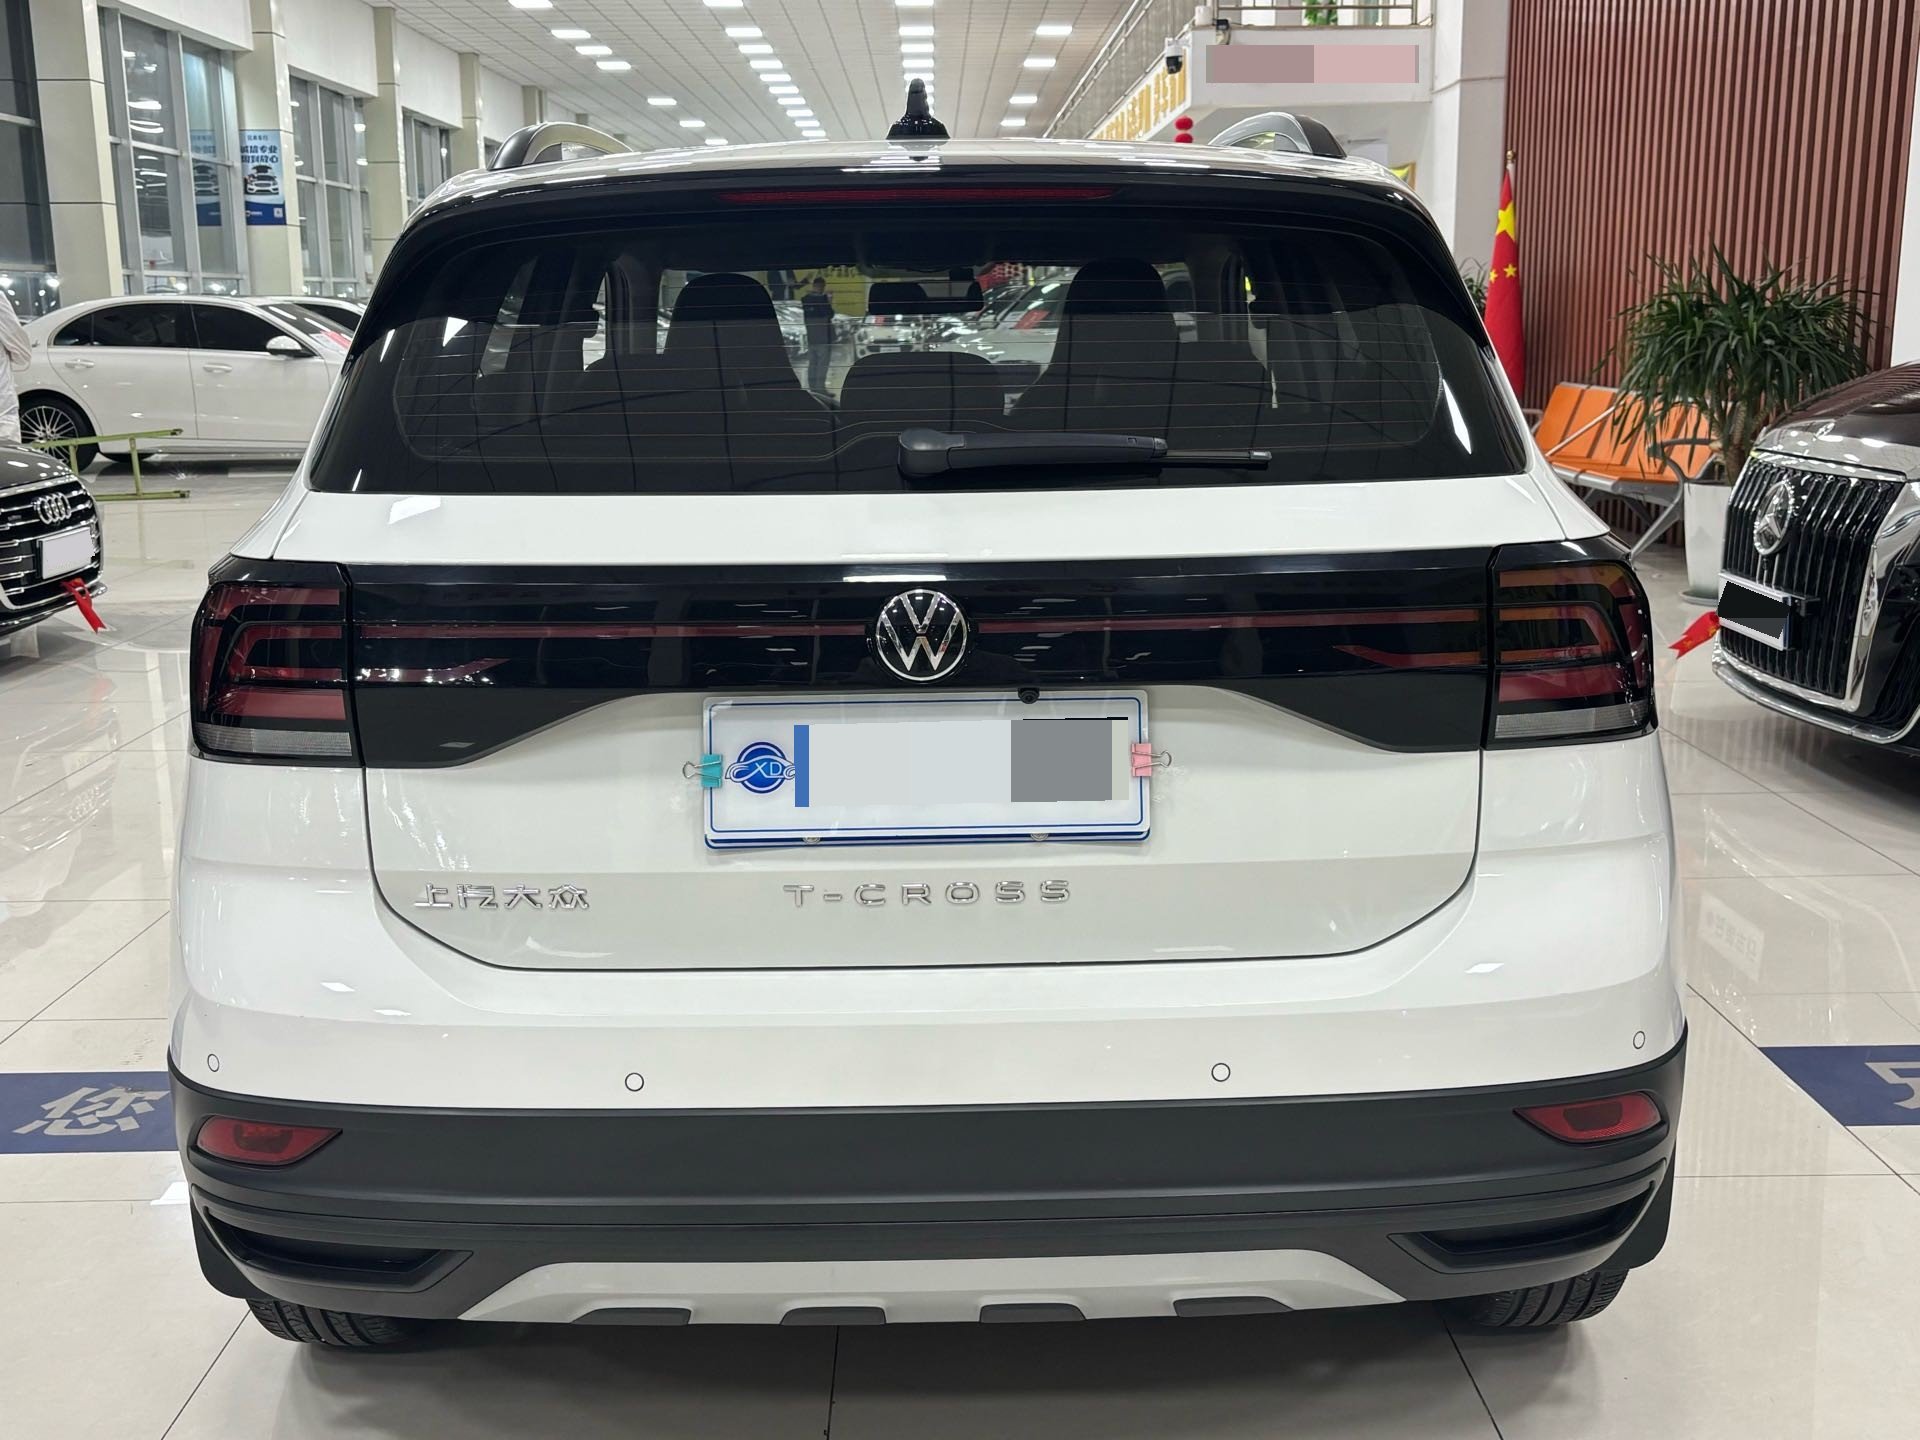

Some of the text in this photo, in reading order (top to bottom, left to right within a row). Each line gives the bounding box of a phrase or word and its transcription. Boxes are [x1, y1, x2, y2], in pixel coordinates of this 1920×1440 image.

[413, 883, 589, 909] 上汽大众
[783, 879, 1070, 907] T-CROSS
[12, 1086, 171, 1136] 您
